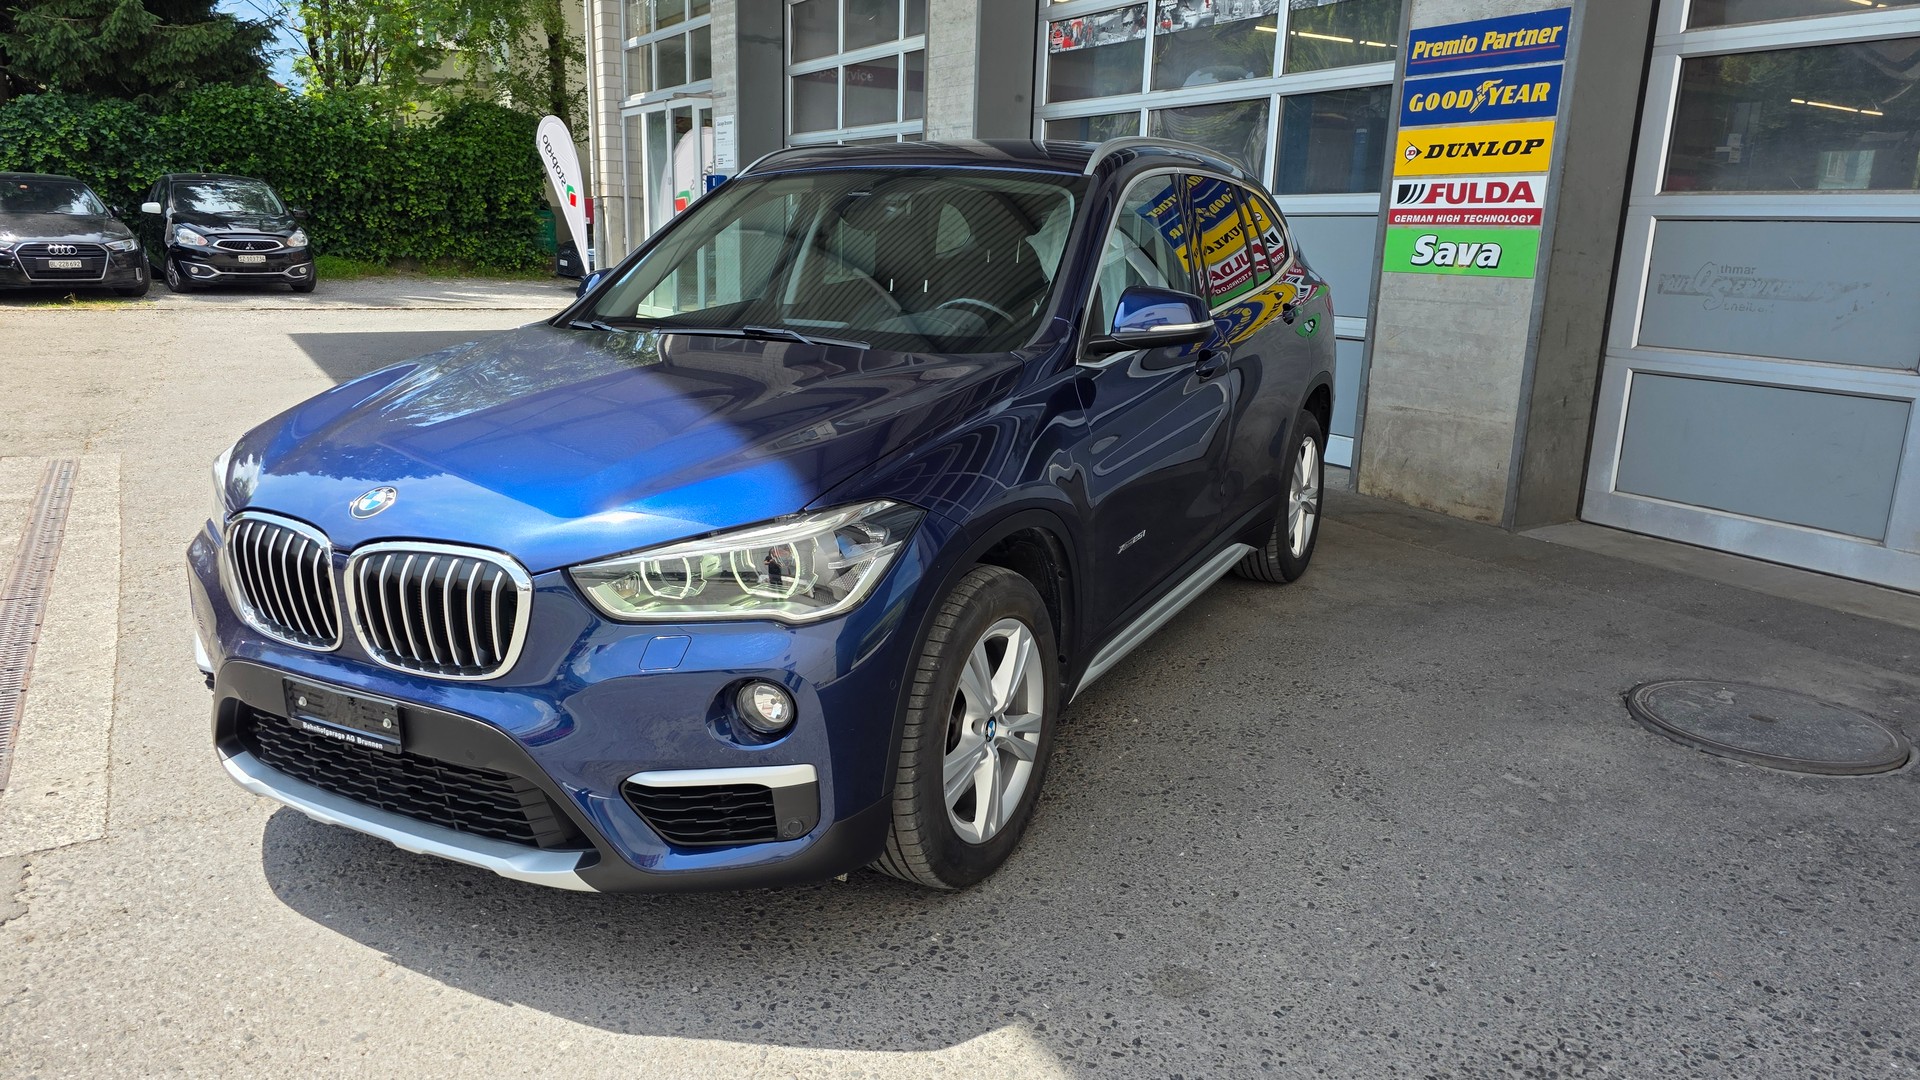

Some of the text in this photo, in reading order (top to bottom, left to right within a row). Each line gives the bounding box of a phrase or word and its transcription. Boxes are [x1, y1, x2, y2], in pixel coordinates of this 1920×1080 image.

[1412, 25, 1563, 60] Premio Partner
[1424, 138, 1545, 159] DUNLOP
[1419, 181, 1535, 205] FULDA
[1394, 214, 1534, 223] GERMAN HIGH TECHNOLOGY
[1410, 234, 1502, 268] Sava
[357, 737, 383, 750] Brunnen
